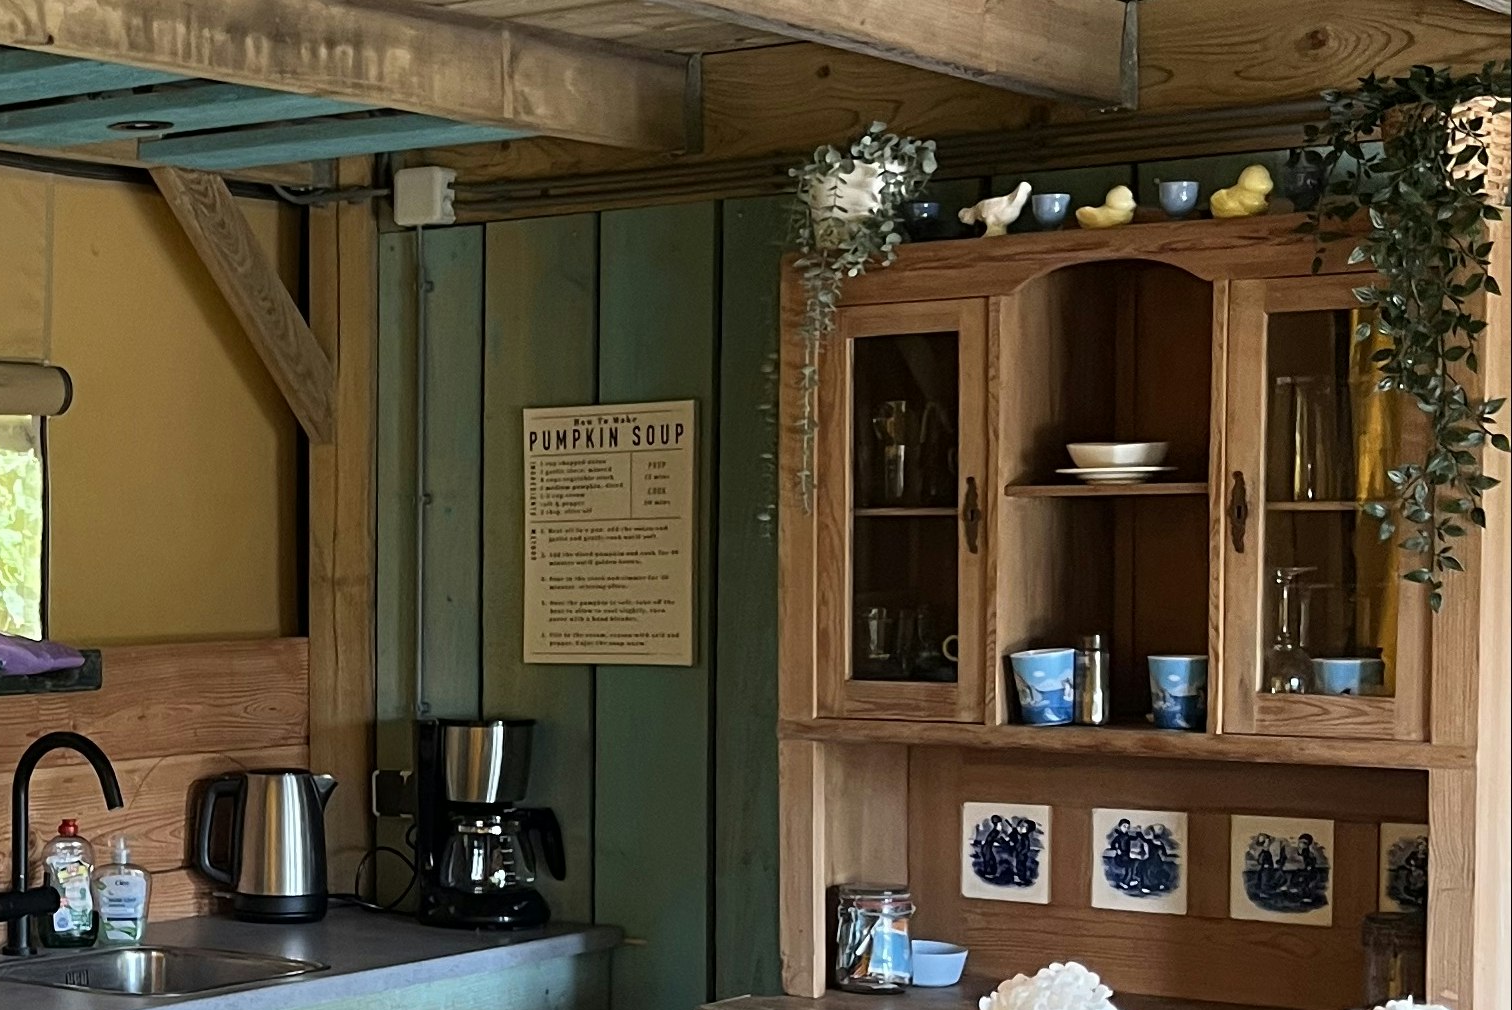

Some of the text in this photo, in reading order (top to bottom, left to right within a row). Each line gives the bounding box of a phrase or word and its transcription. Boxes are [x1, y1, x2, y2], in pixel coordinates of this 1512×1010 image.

[573, 415, 638, 426] How To Make
[529, 423, 684, 452] PUMPKIN SOUP
